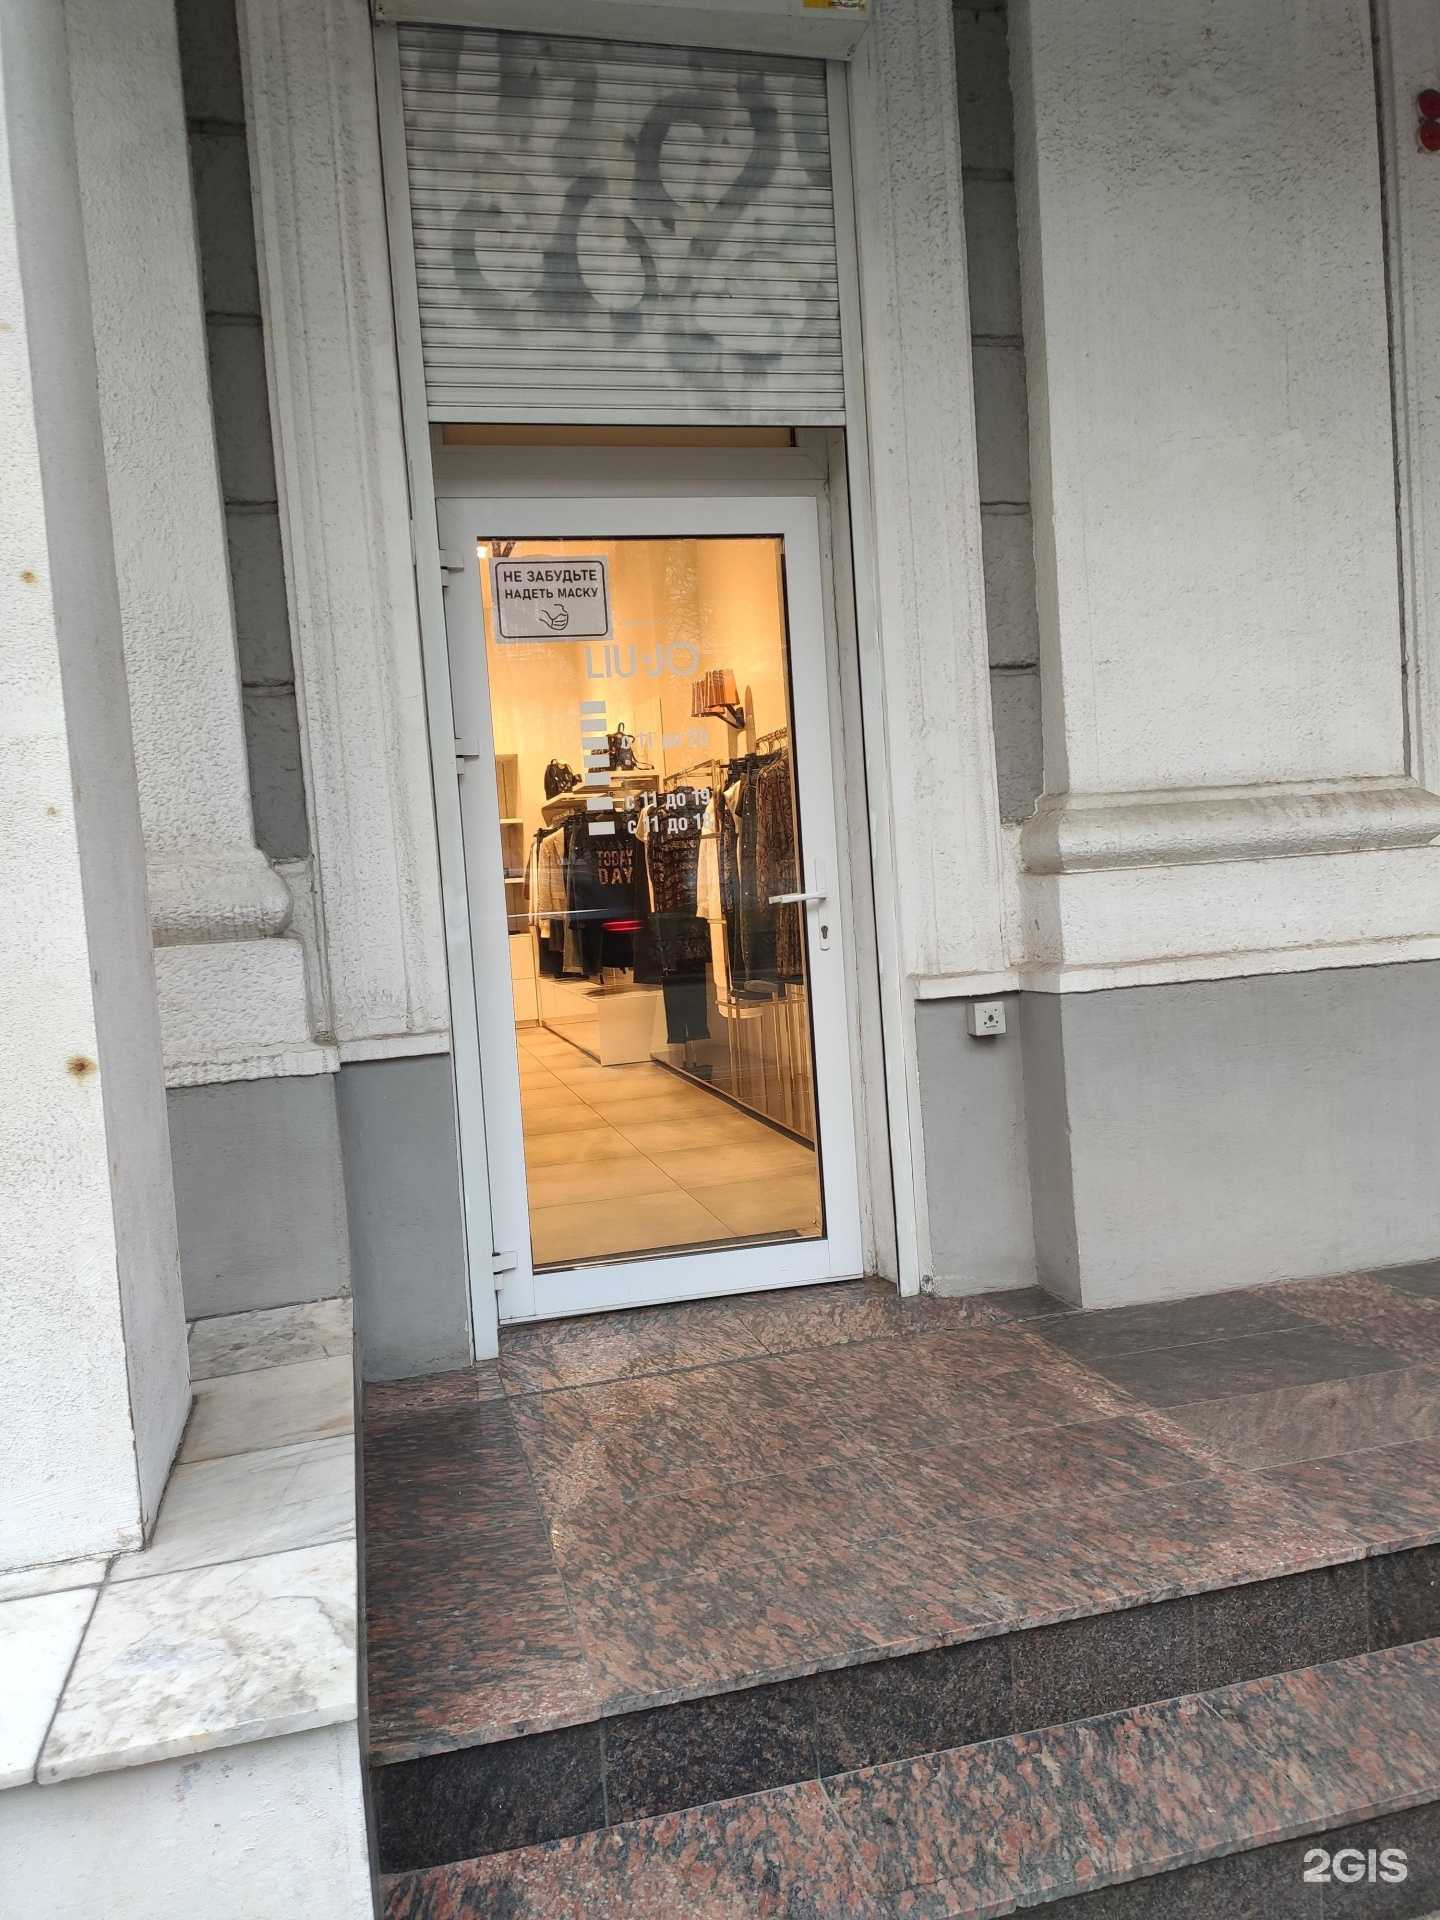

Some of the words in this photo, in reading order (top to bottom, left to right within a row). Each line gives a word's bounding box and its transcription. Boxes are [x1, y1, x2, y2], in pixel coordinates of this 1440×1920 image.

[503, 570, 523, 583] НЕ
[527, 569, 598, 584] ЗАБУДЬТЕ
[504, 588, 554, 601] НАДЕТЬ
[557, 586, 599, 599] МАСКУ
[640, 790, 658, 808] 11
[666, 792, 687, 810] до
[692, 788, 710, 806] 19
[644, 815, 660, 833] 11
[667, 817, 689, 834] до
[597, 848, 633, 867] TODAY
